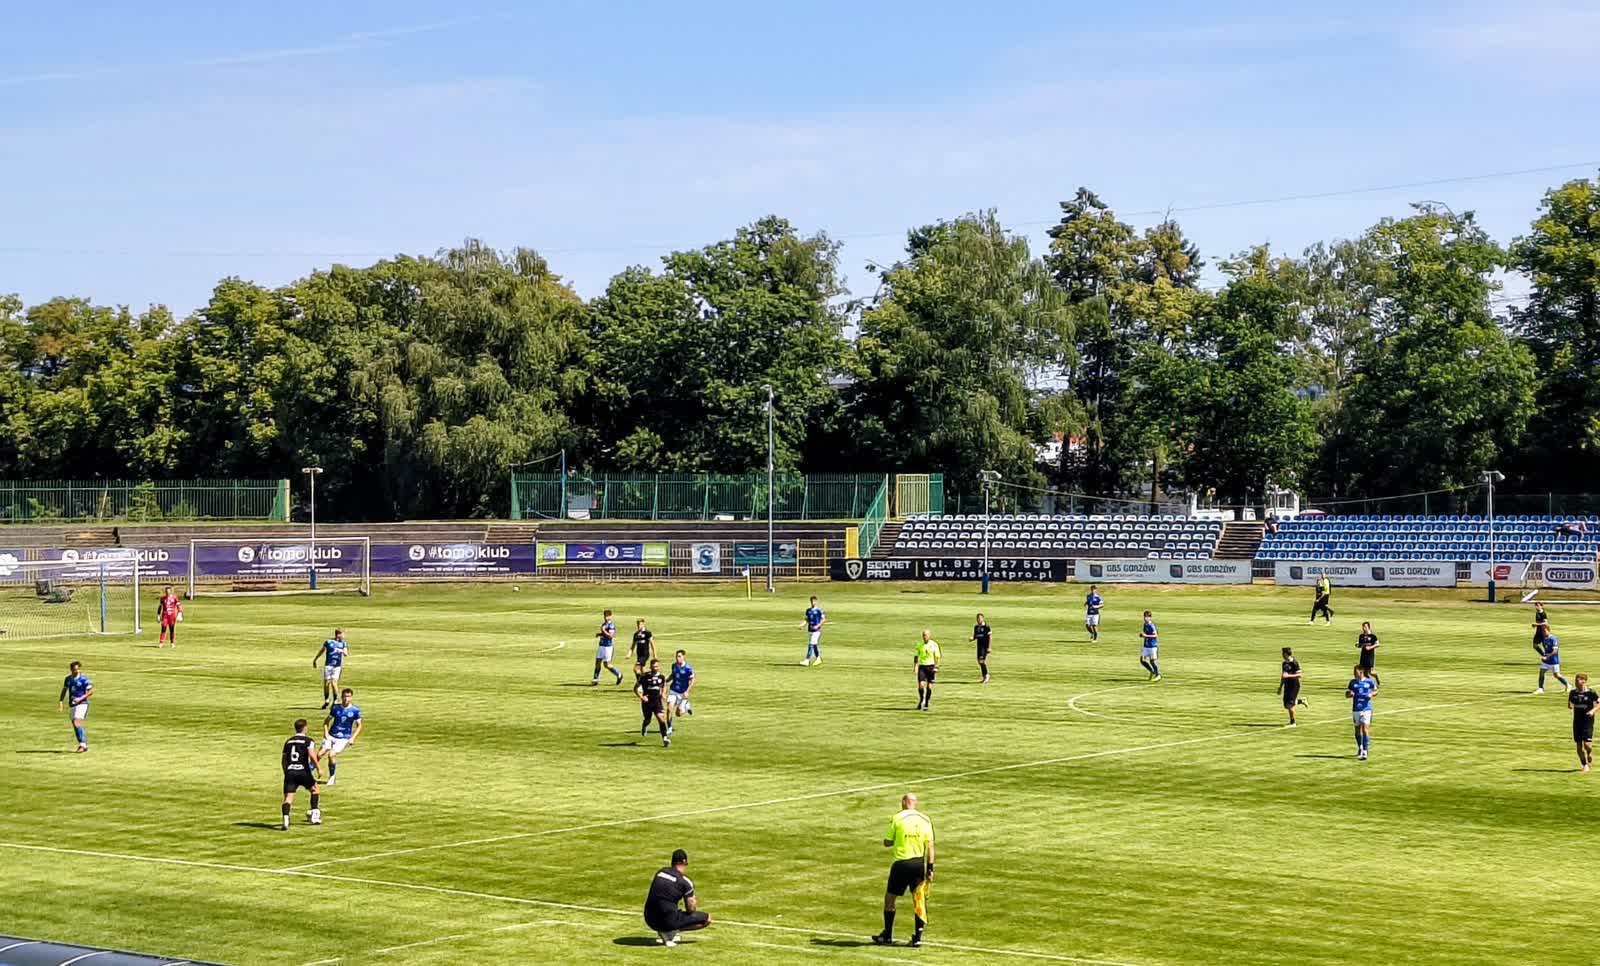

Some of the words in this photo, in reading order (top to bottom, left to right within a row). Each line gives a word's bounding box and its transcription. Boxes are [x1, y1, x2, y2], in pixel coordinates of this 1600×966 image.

[428, 546, 510, 560] #tomojklub
[866, 560, 911, 569] SEKRET
[923, 560, 947, 568] tel.
[954, 560, 971, 568] 95
[977, 560, 994, 568] 72
[1000, 560, 1017, 568] 27
[1023, 560, 1051, 569] 509
[866, 569, 891, 578] PRO
[923, 570, 1052, 580] www.sekretpro.pl
[290, 745, 300, 761] 6
